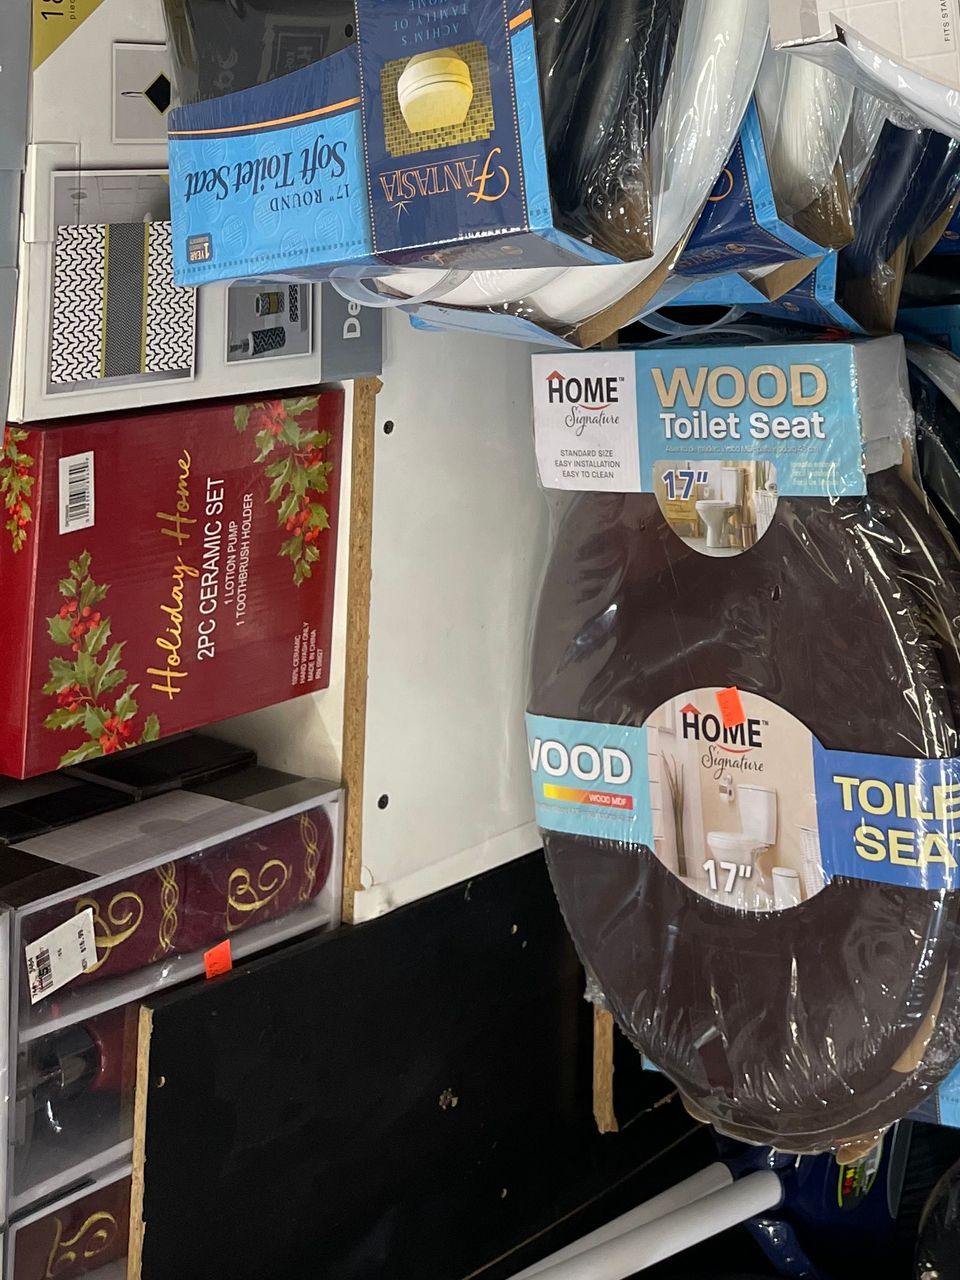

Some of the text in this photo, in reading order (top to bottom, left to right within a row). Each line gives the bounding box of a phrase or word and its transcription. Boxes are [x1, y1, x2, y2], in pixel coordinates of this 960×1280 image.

[393, 3, 469, 32] FAMILY OF
[942, 21, 950, 42] FITS
[183, 134, 348, 202] Soft Toilet Seat
[378, 147, 509, 205] FANTASIA
[270, 190, 324, 213] ROUND
[651, 363, 828, 408] WOOD
[564, 405, 619, 436] Signature
[659, 410, 826, 440] Toilet Seat
[555, 460, 620, 468] EASY INSTALLATION
[560, 450, 614, 458] STANDARD SIZE
[562, 470, 580, 478] EASY
[591, 471, 614, 479] CLEAN
[242, 493, 254, 541] HOLDER
[227, 520, 239, 552] PUMP
[147, 449, 200, 700] Holiday Home
[197, 477, 225, 661] 2PC CERAMIC SET
[224, 554, 236, 597] LOTION
[237, 544, 250, 618] TOOTHBRUSH
[293, 634, 301, 667] CERAMIC
[309, 629, 317, 652] CHINA
[307, 661, 315, 682] MADE
[702, 745, 764, 779] Signature
[588, 794, 627, 807] WOOD MDF
